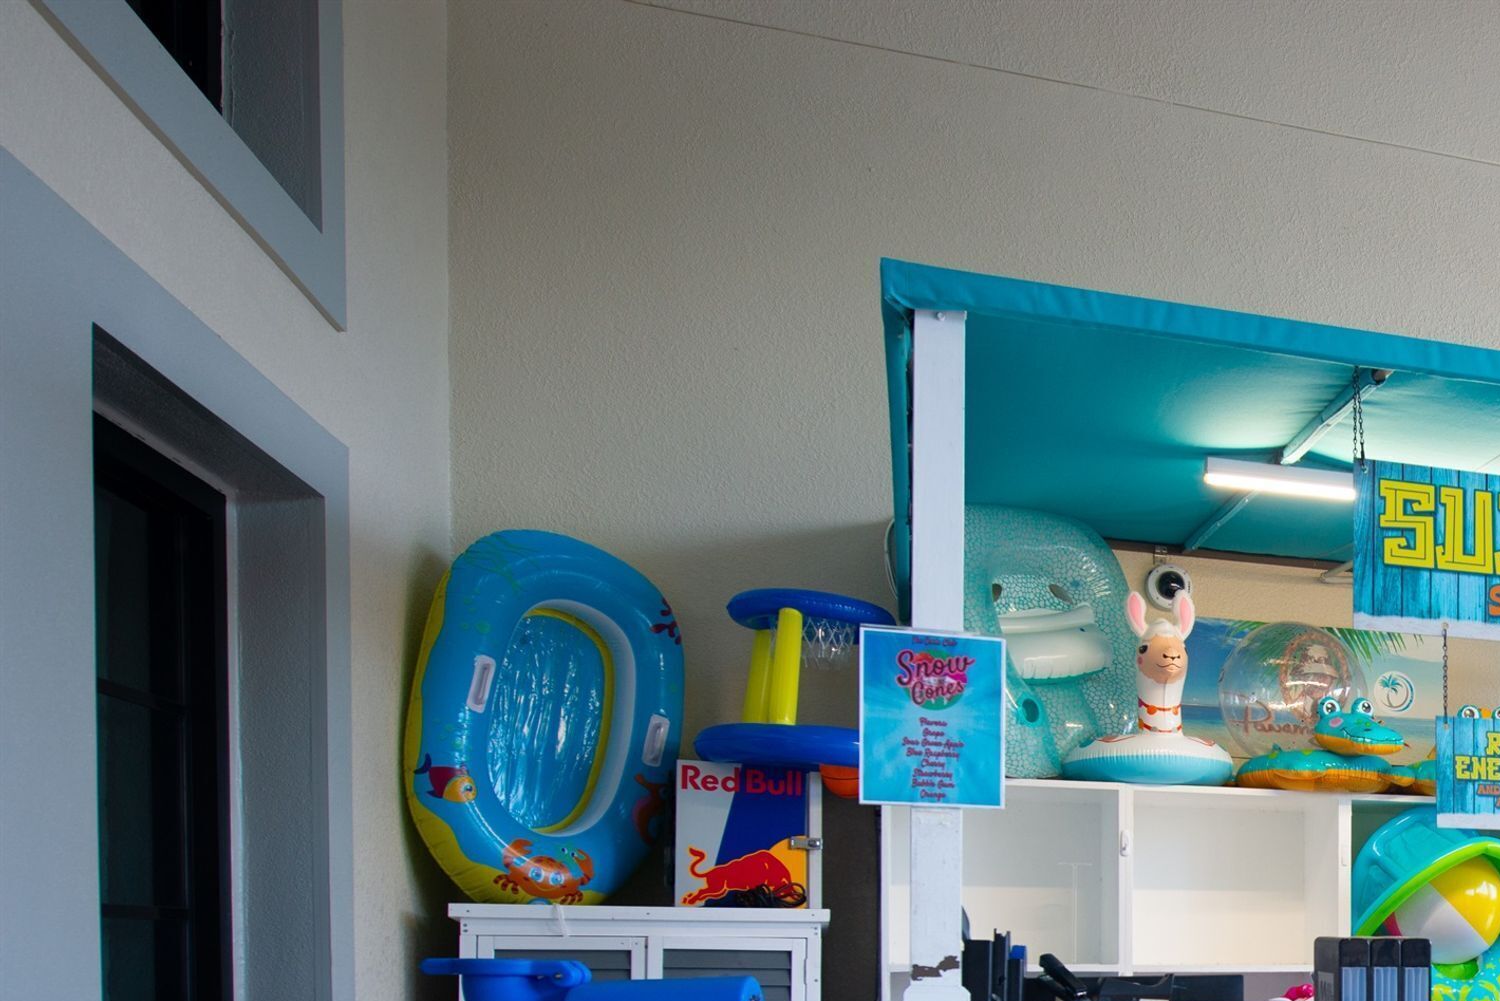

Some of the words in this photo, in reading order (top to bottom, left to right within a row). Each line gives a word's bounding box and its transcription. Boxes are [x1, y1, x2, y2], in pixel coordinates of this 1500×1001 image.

[896, 649, 976, 686] Snow
[911, 680, 965, 705] Cones
[681, 764, 741, 793] Red
[745, 768, 801, 796] Bull
[1477, 784, 1500, 795] AND
